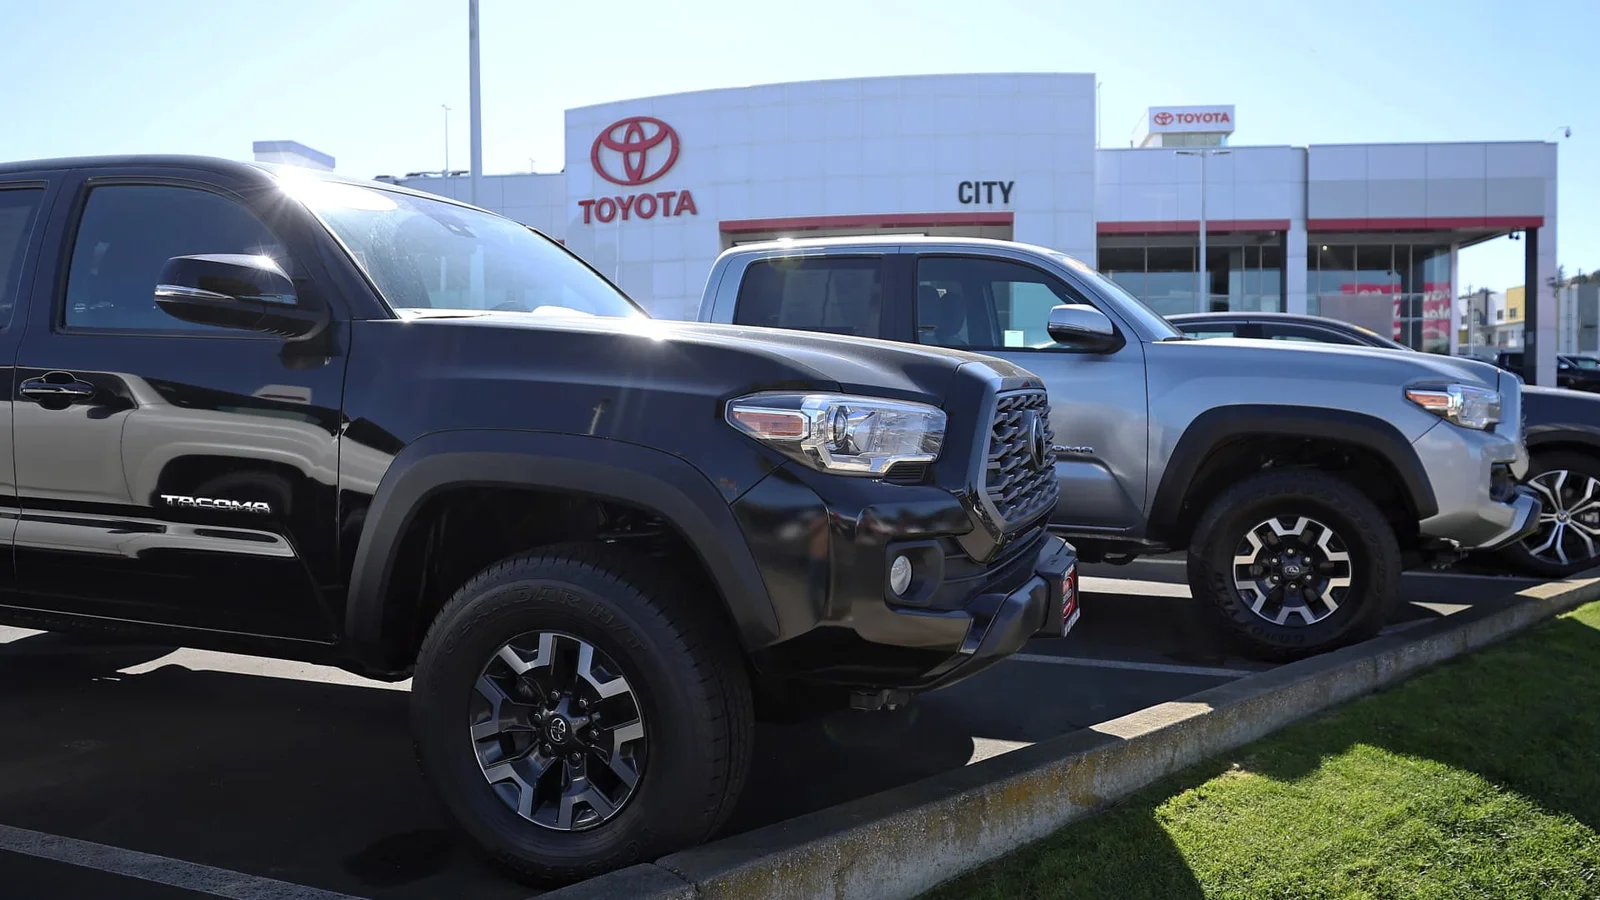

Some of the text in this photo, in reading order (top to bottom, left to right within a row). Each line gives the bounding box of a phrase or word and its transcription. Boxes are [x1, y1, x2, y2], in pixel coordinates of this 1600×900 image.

[1176, 112, 1230, 124] TOYOTA
[958, 181, 1014, 204] CITY
[578, 190, 697, 224] TOYOTA
[160, 494, 271, 513] TACOMA
